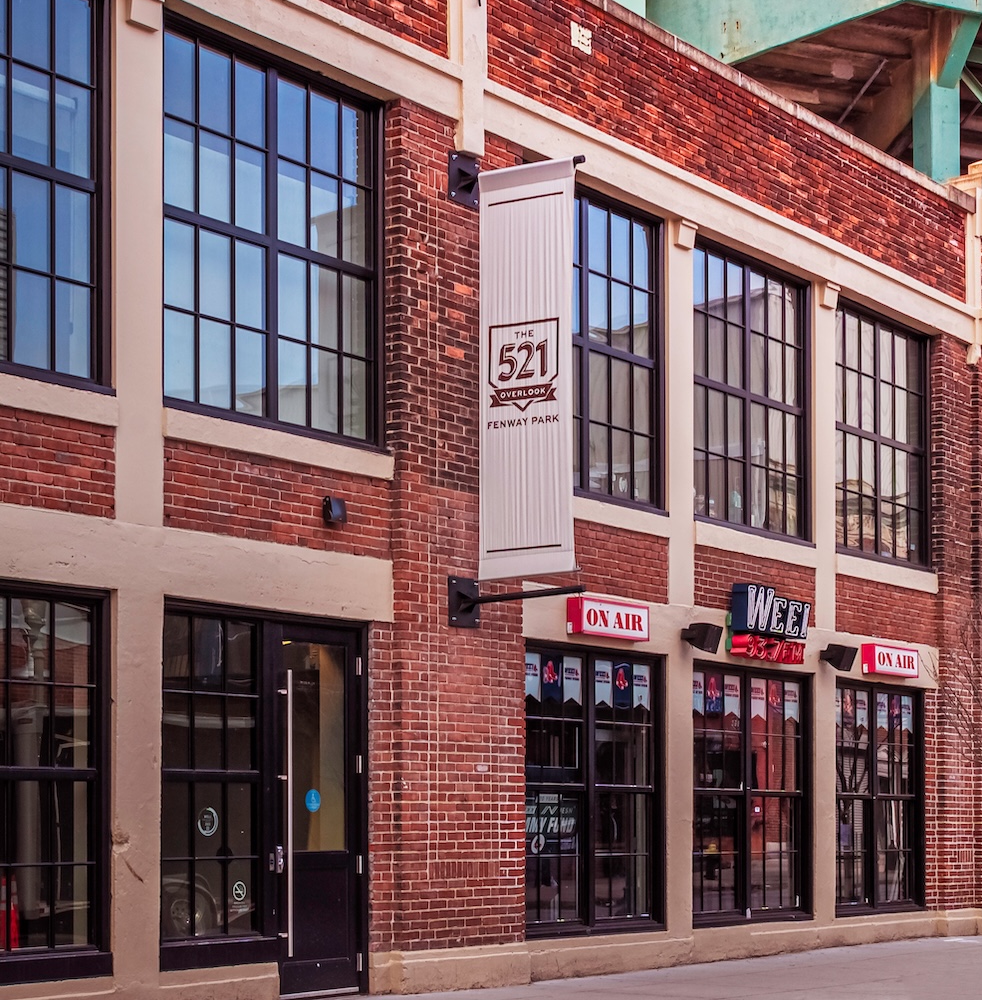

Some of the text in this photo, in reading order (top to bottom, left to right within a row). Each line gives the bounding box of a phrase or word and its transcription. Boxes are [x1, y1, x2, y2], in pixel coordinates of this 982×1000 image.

[514, 329, 534, 340] THE
[498, 338, 548, 382] 521
[500, 386, 546, 400] OVERLOOK
[487, 413, 560, 430] FENWAY PARK
[586, 607, 644, 632] ON AIR
[746, 584, 811, 638] WEEI
[877, 651, 915, 670] ON AIR
